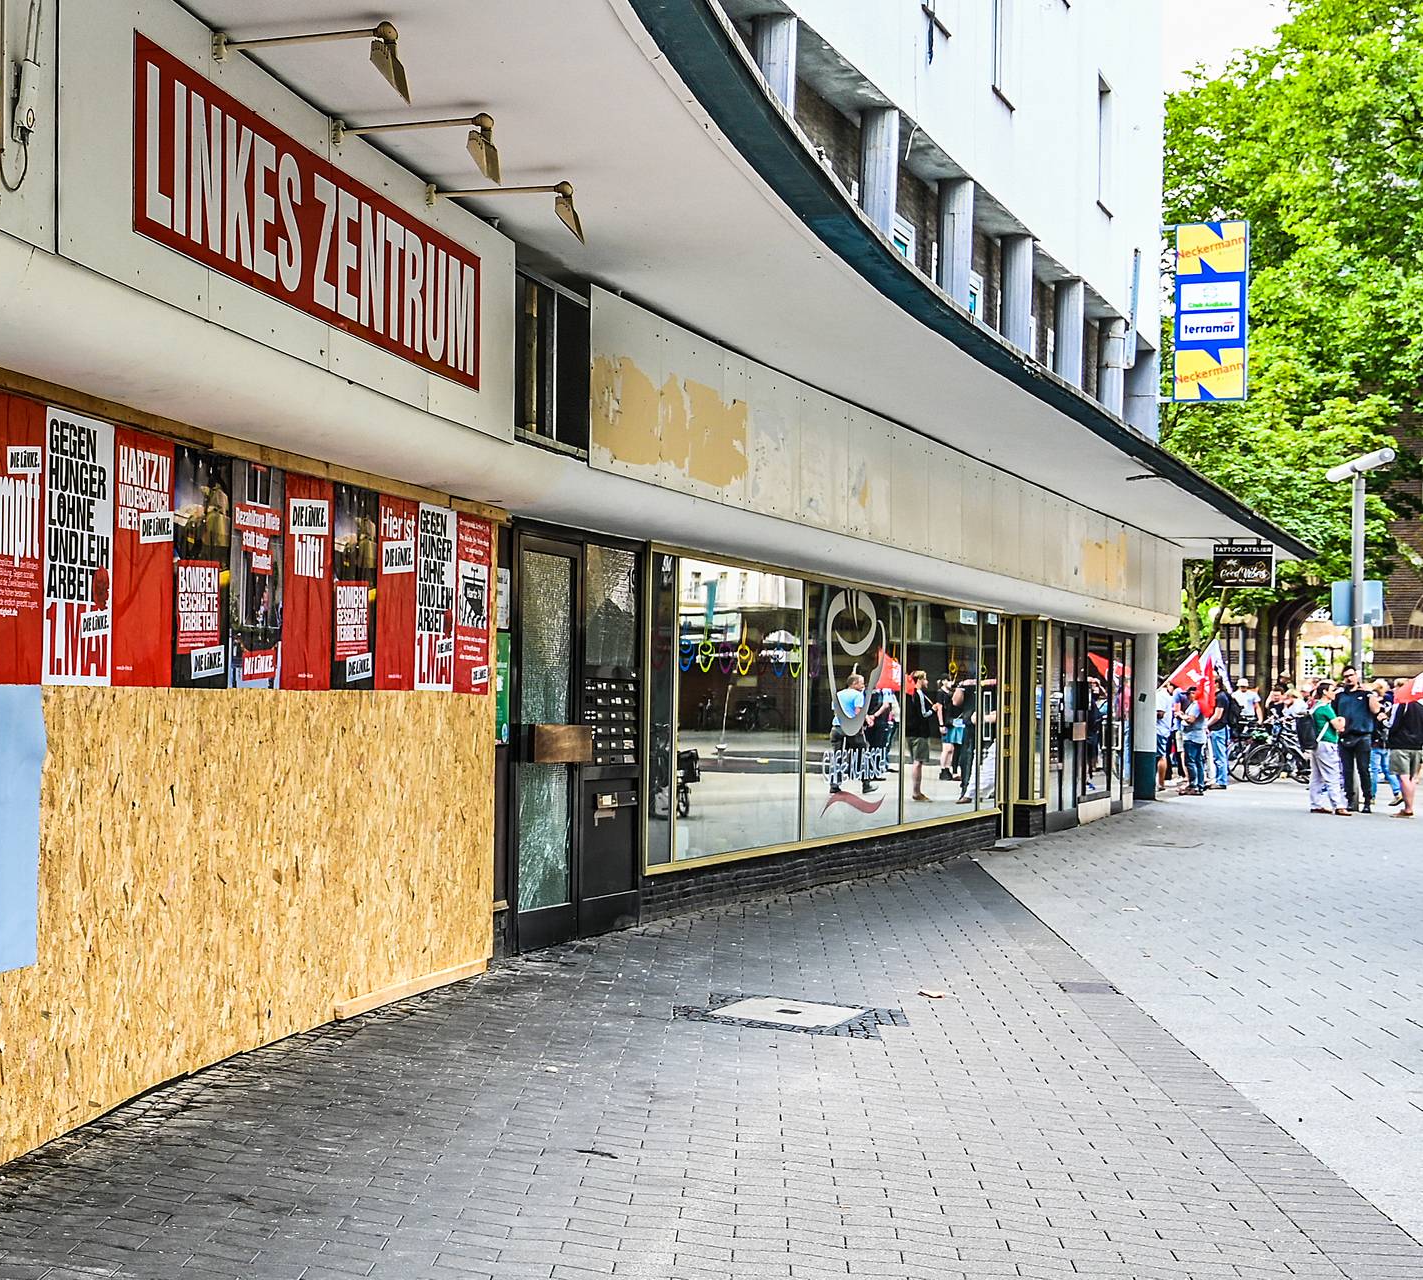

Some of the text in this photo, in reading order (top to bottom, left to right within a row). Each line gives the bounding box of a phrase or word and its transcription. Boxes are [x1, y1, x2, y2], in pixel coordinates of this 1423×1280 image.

[146, 60, 475, 376] LINKES ZENTRUM
[1176, 236, 1246, 259] Neckermann
[1175, 361, 1245, 385] Neckermann
[49, 419, 97, 463] GEGEN
[10, 451, 20, 468] DIE
[119, 445, 171, 493] HARTZ IV
[49, 454, 107, 500] HUNGER
[142, 518, 153, 537] DIE
[292, 505, 304, 527] DIE
[381, 506, 415, 542] Hier ist
[420, 509, 447, 538] GEGEN
[294, 533, 324, 579] hilft!
[385, 547, 395, 568] DIE
[419, 534, 453, 563] HUNGER
[47, 563, 96, 602] ARBEIT
[178, 566, 219, 592] BOMBEN
[178, 592, 219, 612] GESCHÄFTE
[337, 586, 368, 609] BOMBEN
[179, 612, 218, 631] VERBIETEN!
